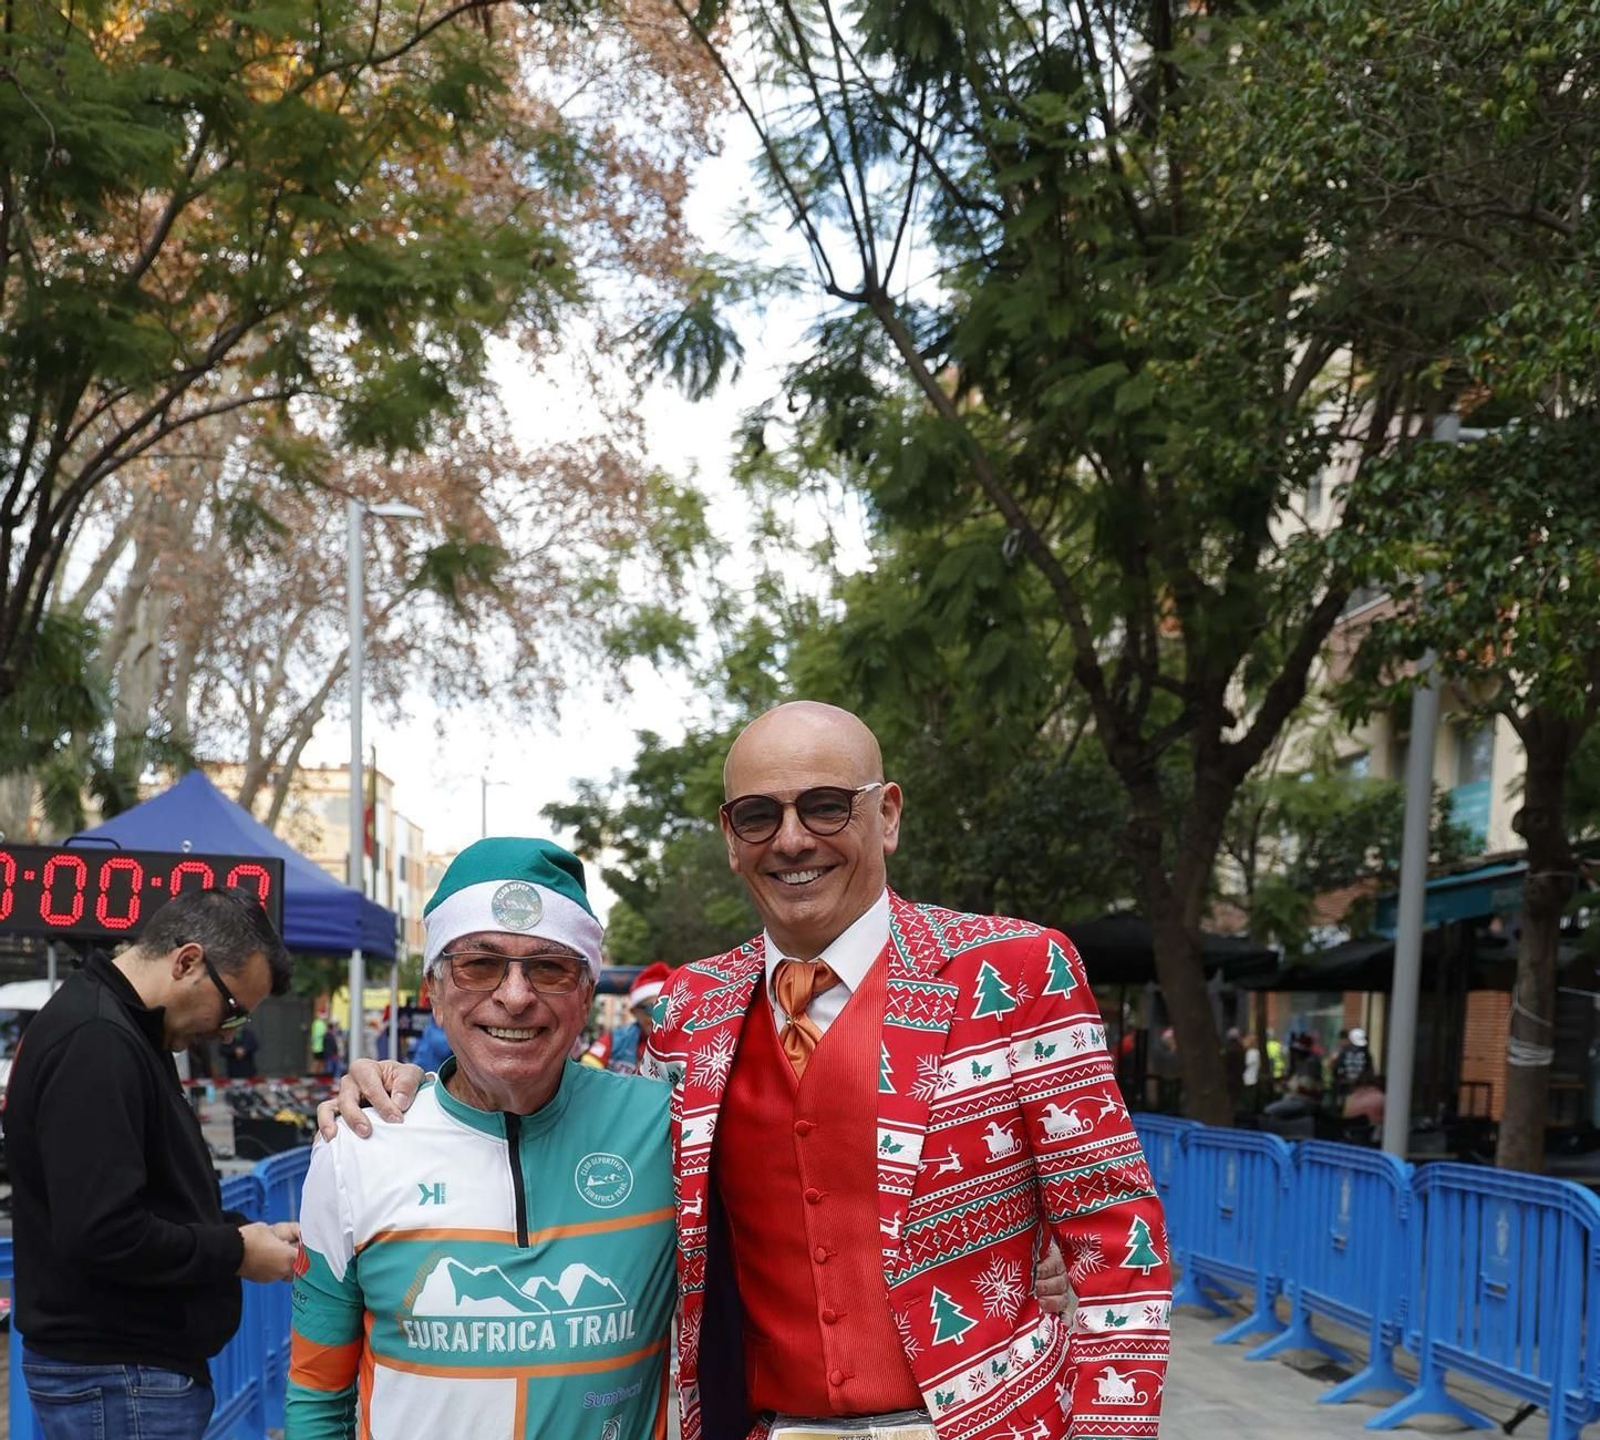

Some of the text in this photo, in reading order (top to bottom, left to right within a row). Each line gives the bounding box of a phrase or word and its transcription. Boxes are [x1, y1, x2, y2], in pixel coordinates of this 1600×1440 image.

[590, 1157, 624, 1171] DEPORTIVO
[403, 1310, 637, 1353] EURAFRICA TRAIL
